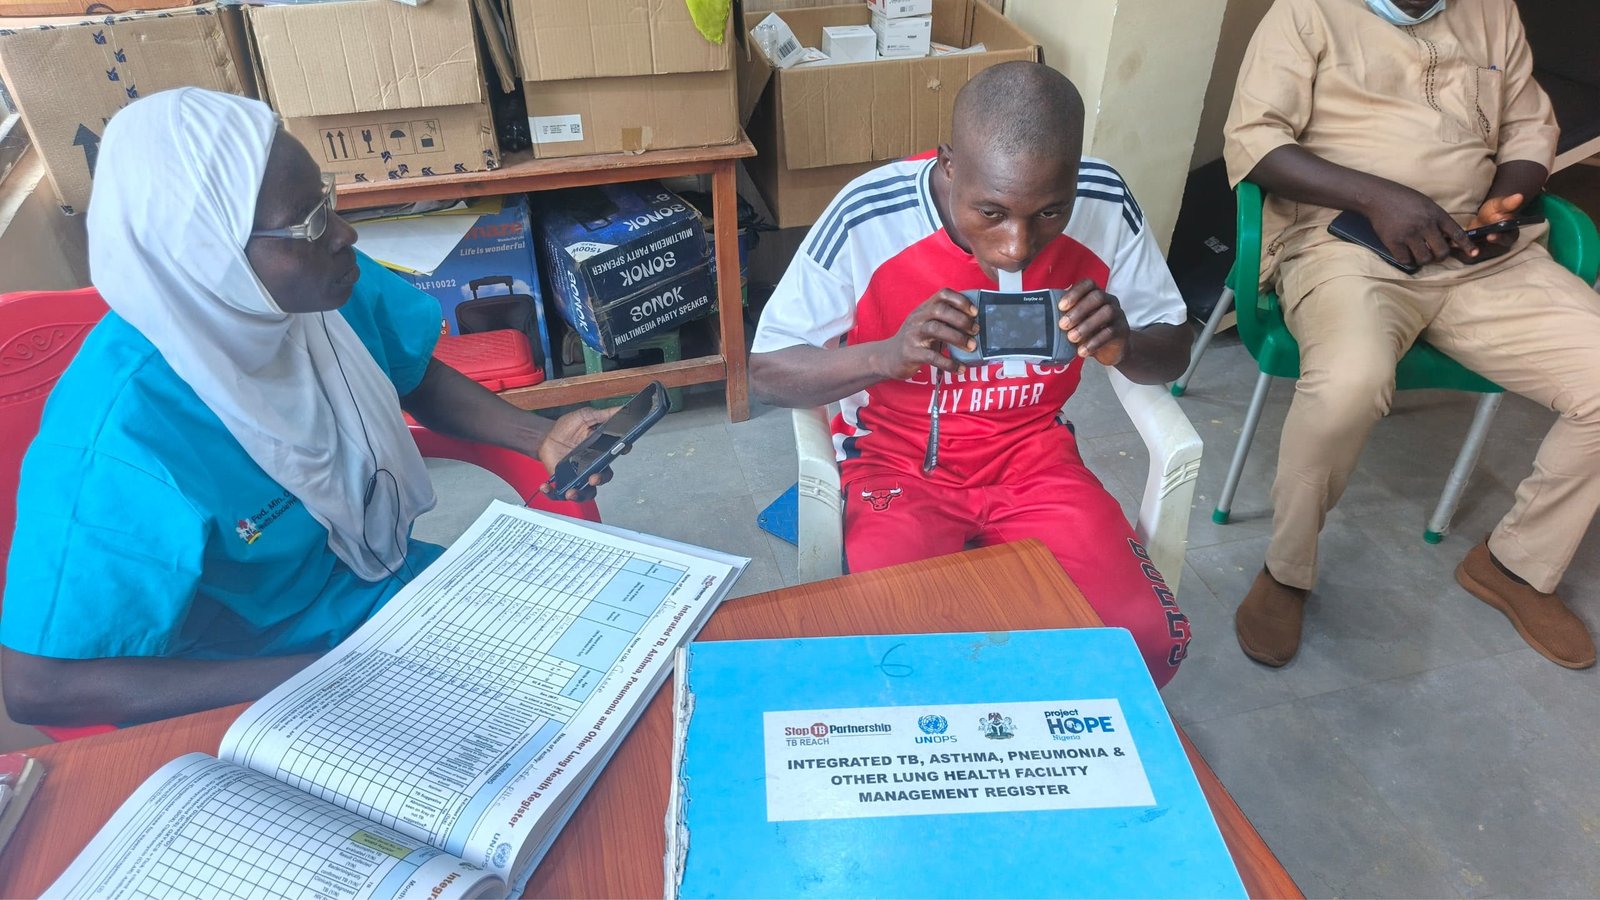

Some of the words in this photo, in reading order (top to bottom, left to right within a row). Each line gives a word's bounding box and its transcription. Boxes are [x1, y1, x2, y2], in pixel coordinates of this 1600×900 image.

[623, 204, 686, 232] SONOK
[460, 246, 476, 257] Life
[485, 241, 525, 254] wonderful
[650, 228, 693, 252] MULTIMEDIA
[625, 243, 650, 262] PARTY
[592, 253, 626, 276] SPEAKER
[619, 251, 676, 287] SONOK
[630, 286, 684, 322] SONOK
[615, 322, 656, 346] MULTIMEDIA
[657, 311, 678, 325] PARTY
[679, 295, 708, 315] SPEAKER
[660, 603, 692, 636] Integrated
[628, 636, 641, 648] Name
[652, 635, 668, 648] TB,
[631, 647, 659, 676] Asthma,
[602, 675, 639, 716] Pneumonia
[591, 715, 609, 731] and
[1044, 708, 1078, 718] project
[785, 725, 810, 737] Stop
[812, 724, 827, 736] TB
[829, 722, 892, 735] Partnership
[1050, 716, 1114, 734] HOPE
[551, 731, 566, 745] Name
[574, 729, 598, 752] Other
[786, 739, 797, 747] TB
[799, 738, 829, 746] REACH
[915, 735, 957, 744] UNOPS
[1052, 733, 1081, 741] Nigeria
[531, 747, 551, 765] Facility:
[556, 748, 580, 769] Lung
[788, 755, 892, 770] INTEGRATED
[896, 755, 924, 767] TB,
[928, 752, 1004, 765] ASTHMA,
[1008, 747, 1108, 761] PNEUMONIA
[1113, 747, 1125, 757] &
[486, 760, 512, 786] SCREENING
[535, 765, 564, 793] Health
[831, 773, 888, 786] OTHER
[893, 771, 939, 783] LUNG
[944, 768, 1010, 781] HEALTH
[1015, 765, 1088, 778] FACILITY
[859, 787, 979, 803] MANAGEMENT
[985, 784, 1070, 798] REGISTER
[503, 789, 541, 829] Register
[481, 831, 501, 868] UNOPS
